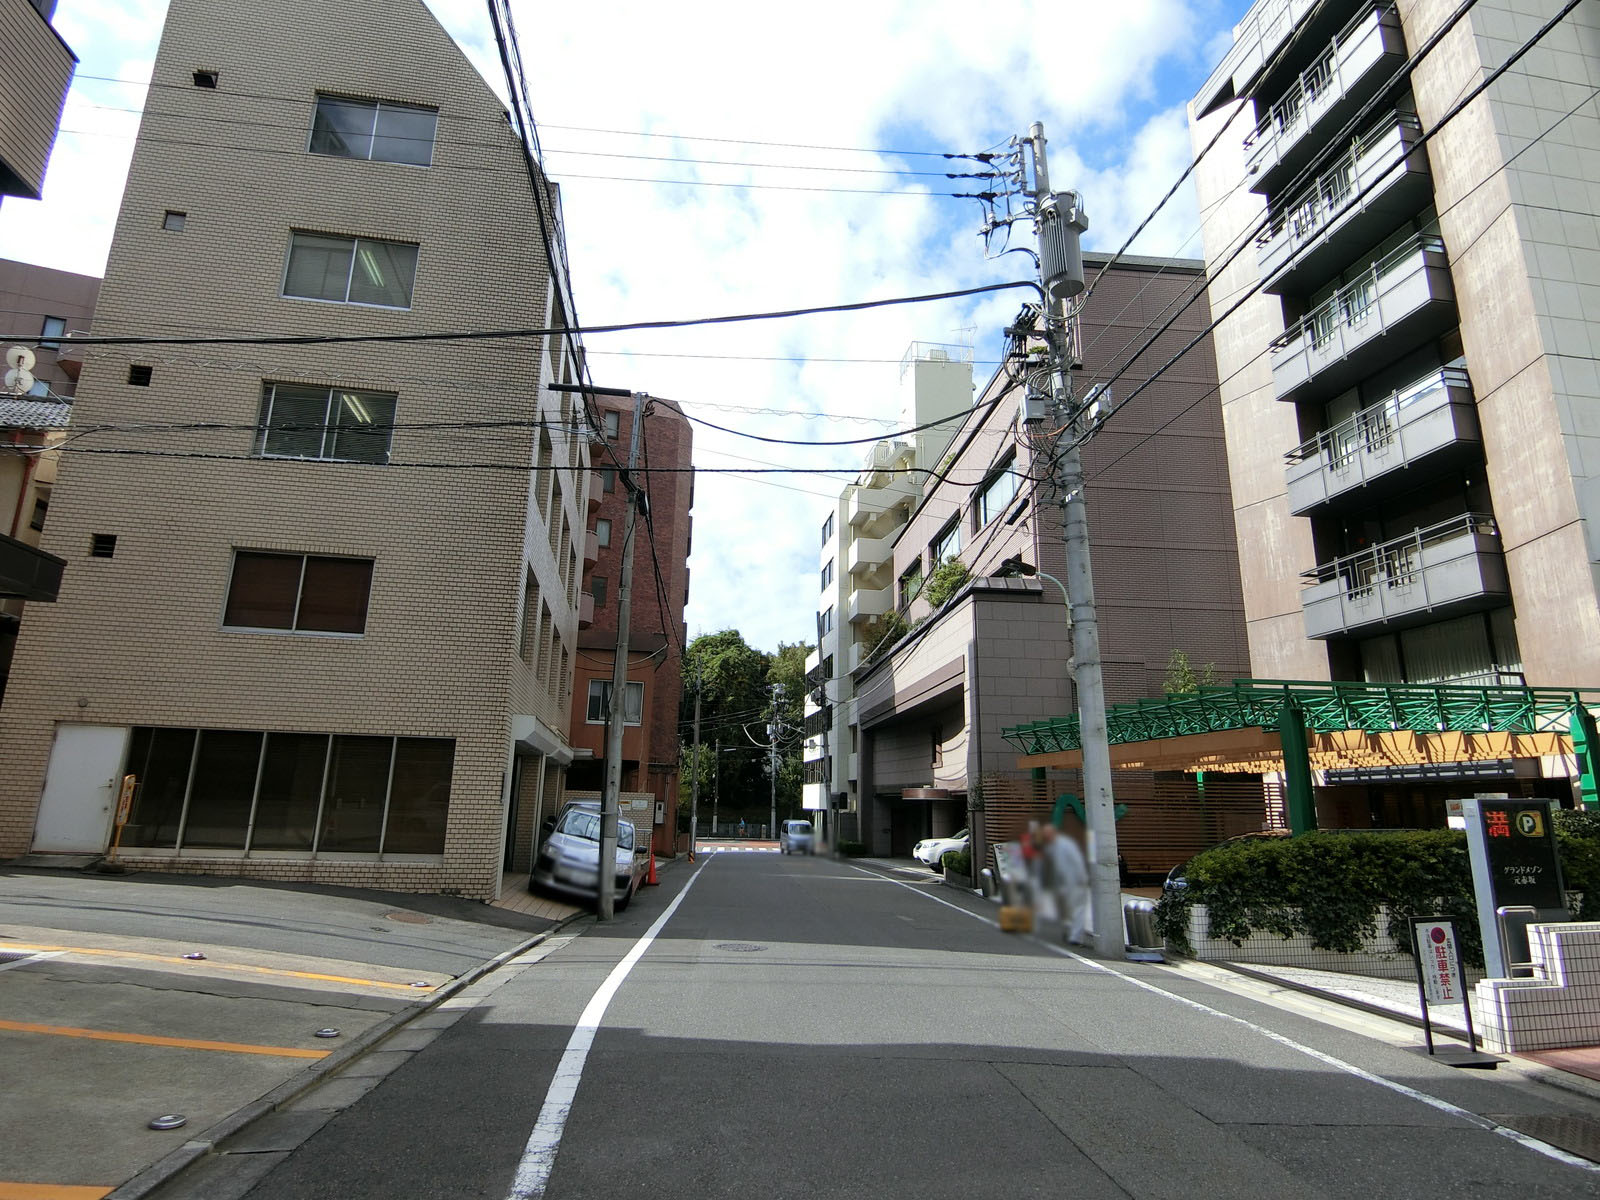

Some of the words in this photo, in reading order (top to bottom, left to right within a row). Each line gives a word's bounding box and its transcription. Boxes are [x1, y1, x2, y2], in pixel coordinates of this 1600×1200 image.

[1486, 811, 1511, 837] 満
[1522, 817, 1534, 832] P
[1504, 866, 1542, 875] グランドメゾン
[1514, 876, 1536, 885] 元赤坂
[1435, 946, 1454, 999] 駐車禁止
